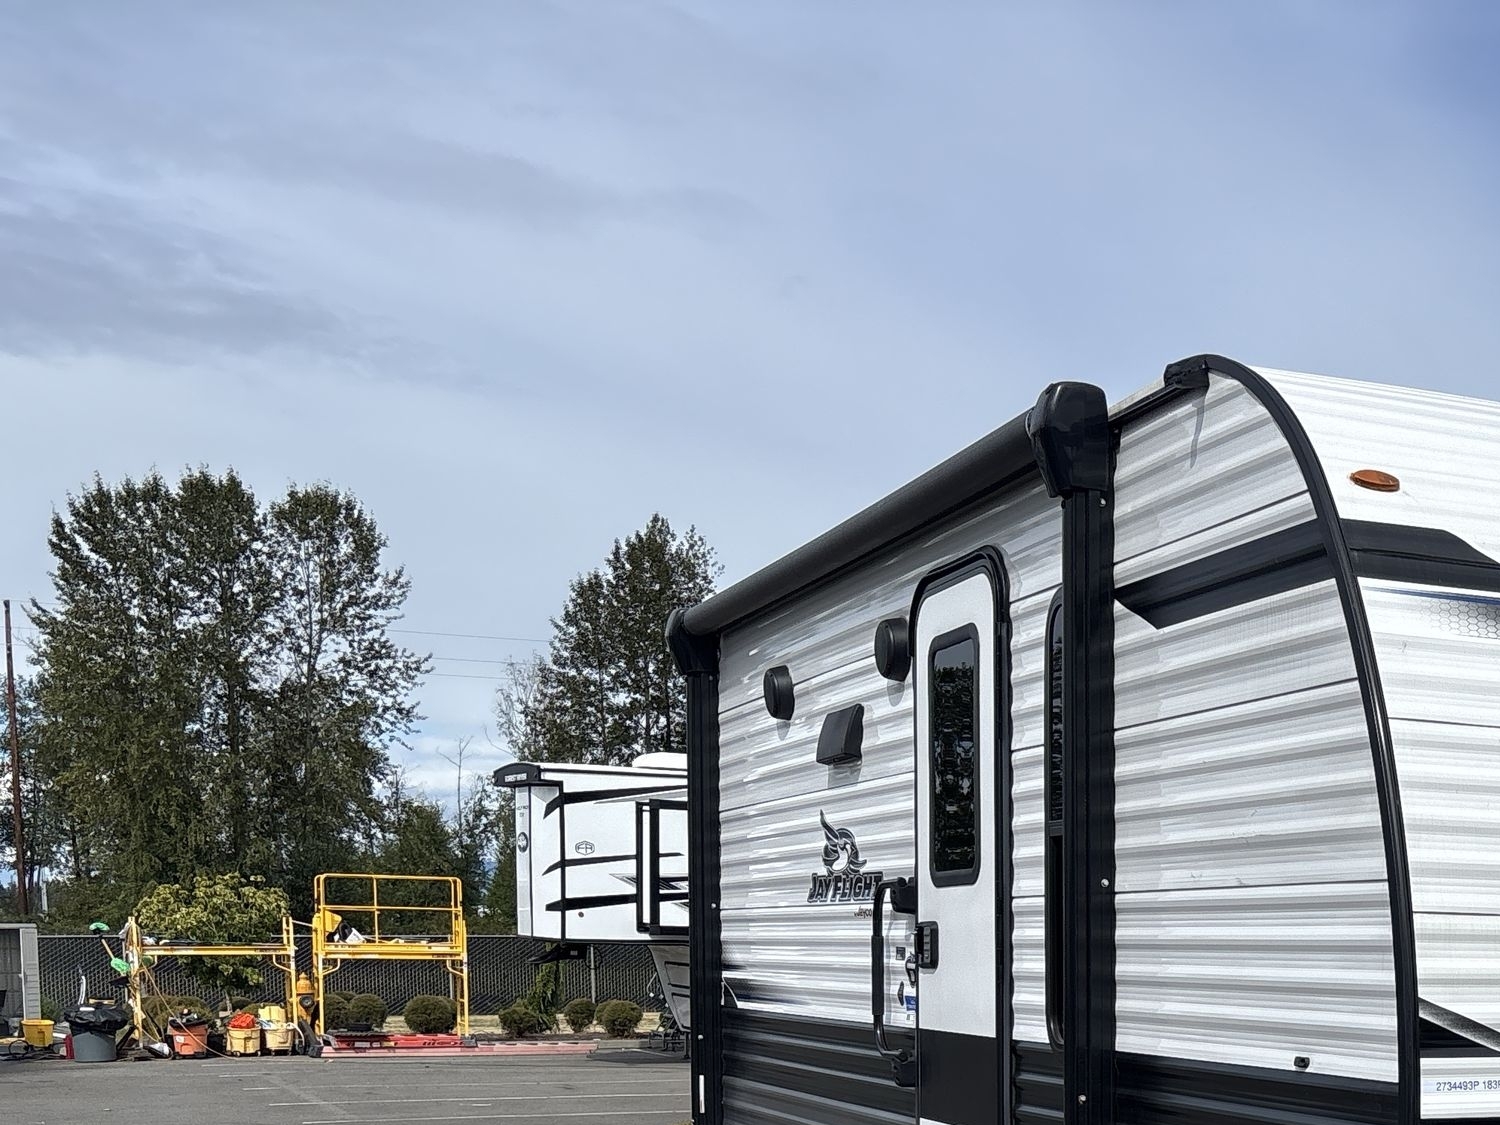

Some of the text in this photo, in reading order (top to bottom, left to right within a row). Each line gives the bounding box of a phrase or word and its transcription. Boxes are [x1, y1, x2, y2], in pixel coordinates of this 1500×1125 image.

[807, 871, 883, 903] JAY FLIGHT
[1436, 1080, 1480, 1091] 2734493P
